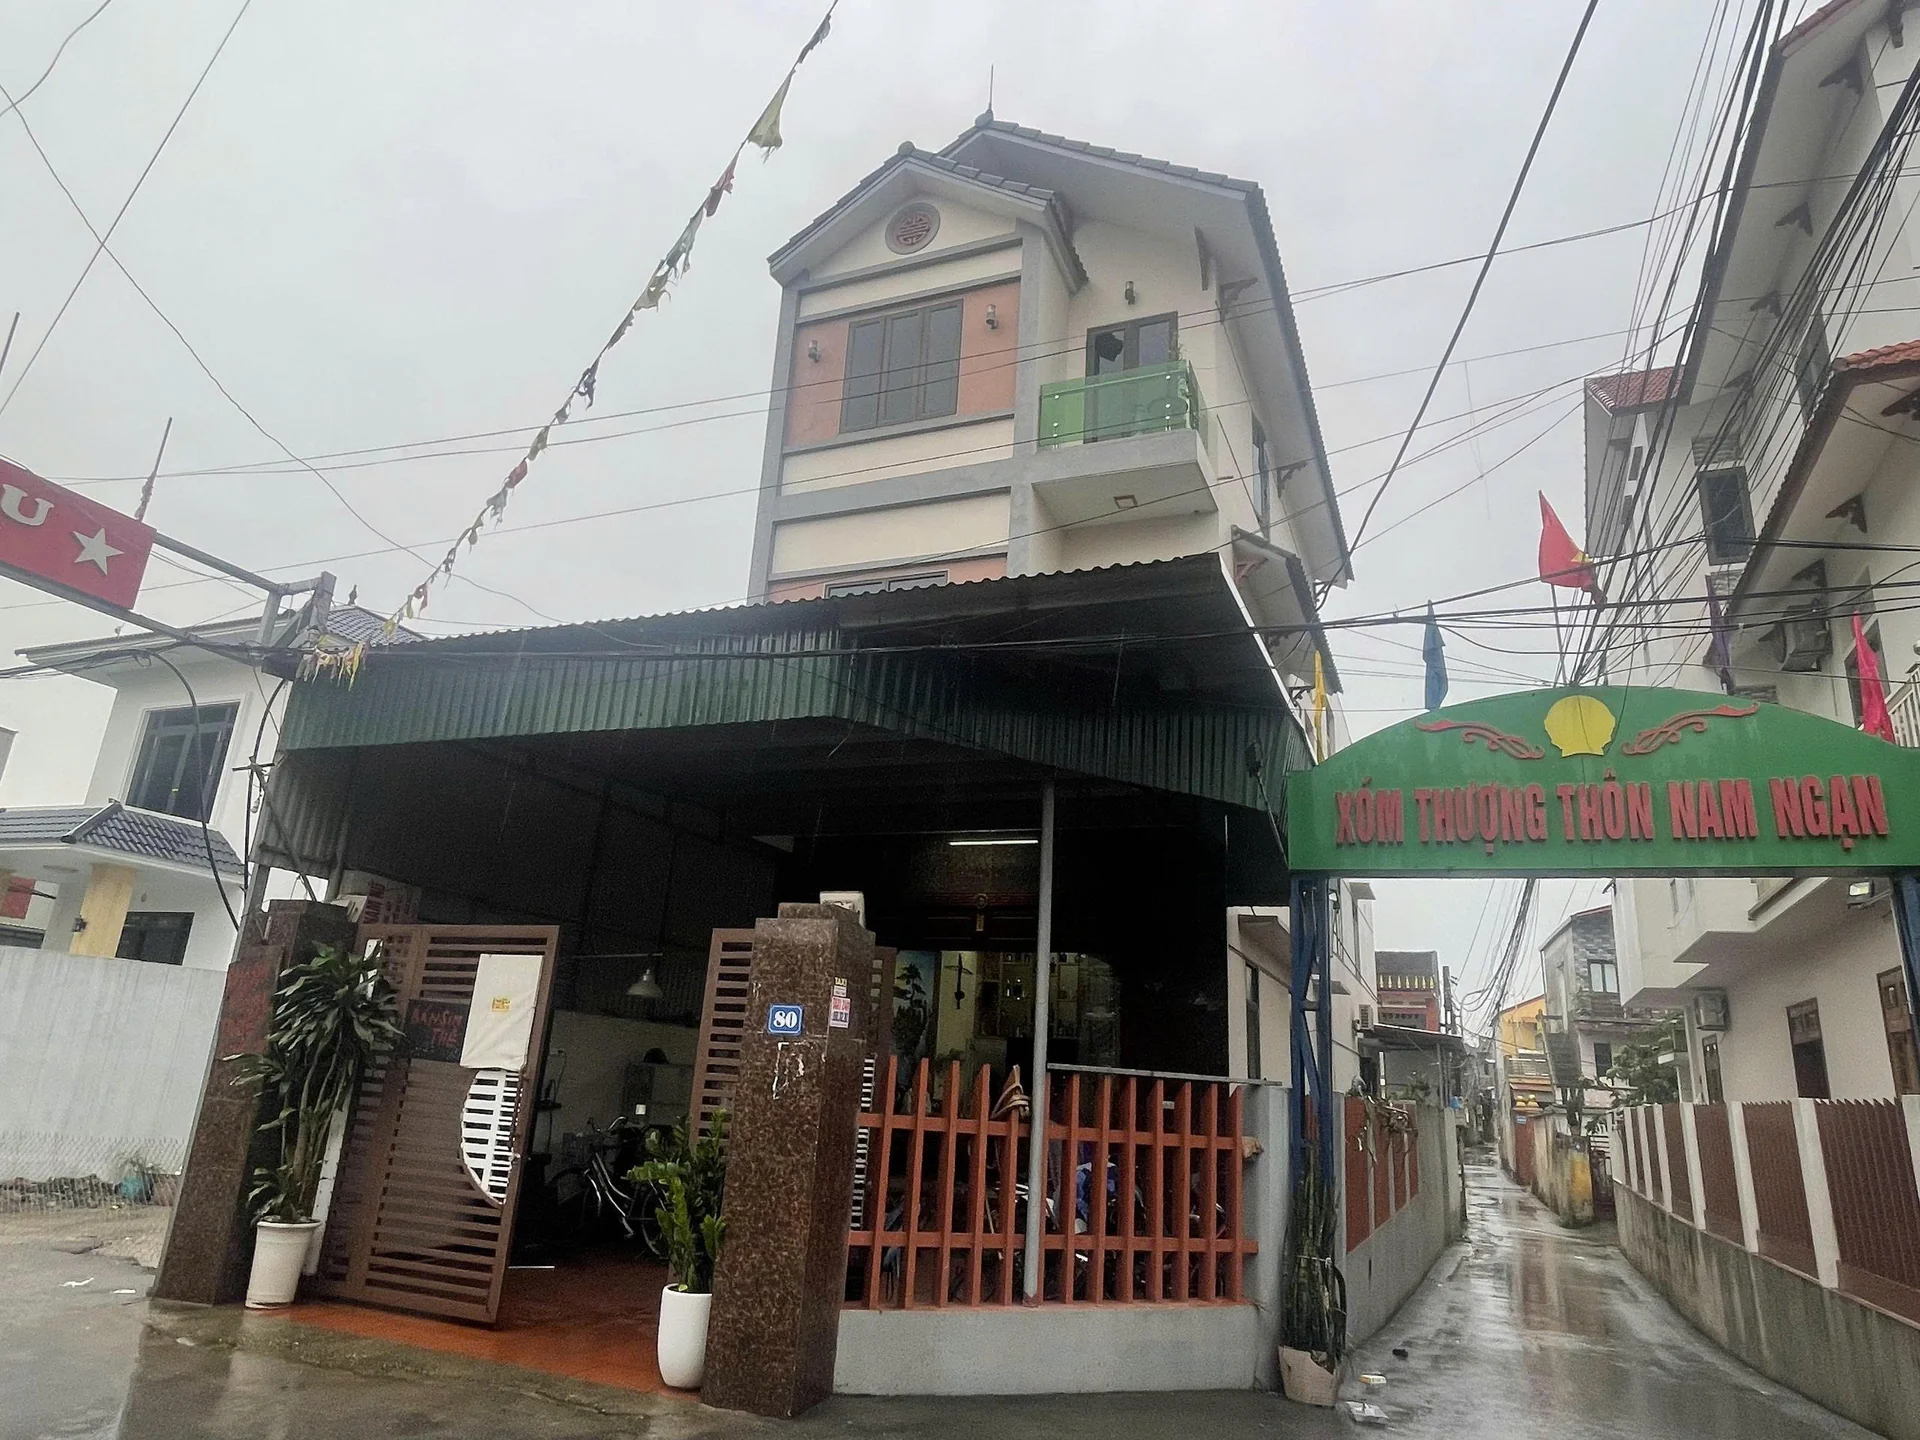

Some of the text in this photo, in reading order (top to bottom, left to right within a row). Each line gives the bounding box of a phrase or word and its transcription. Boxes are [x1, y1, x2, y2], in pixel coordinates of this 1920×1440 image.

[1335, 767, 1888, 856] XÓM THƯỢNG THÔN NAM NGẠN
[773, 1011, 798, 1028] 80
